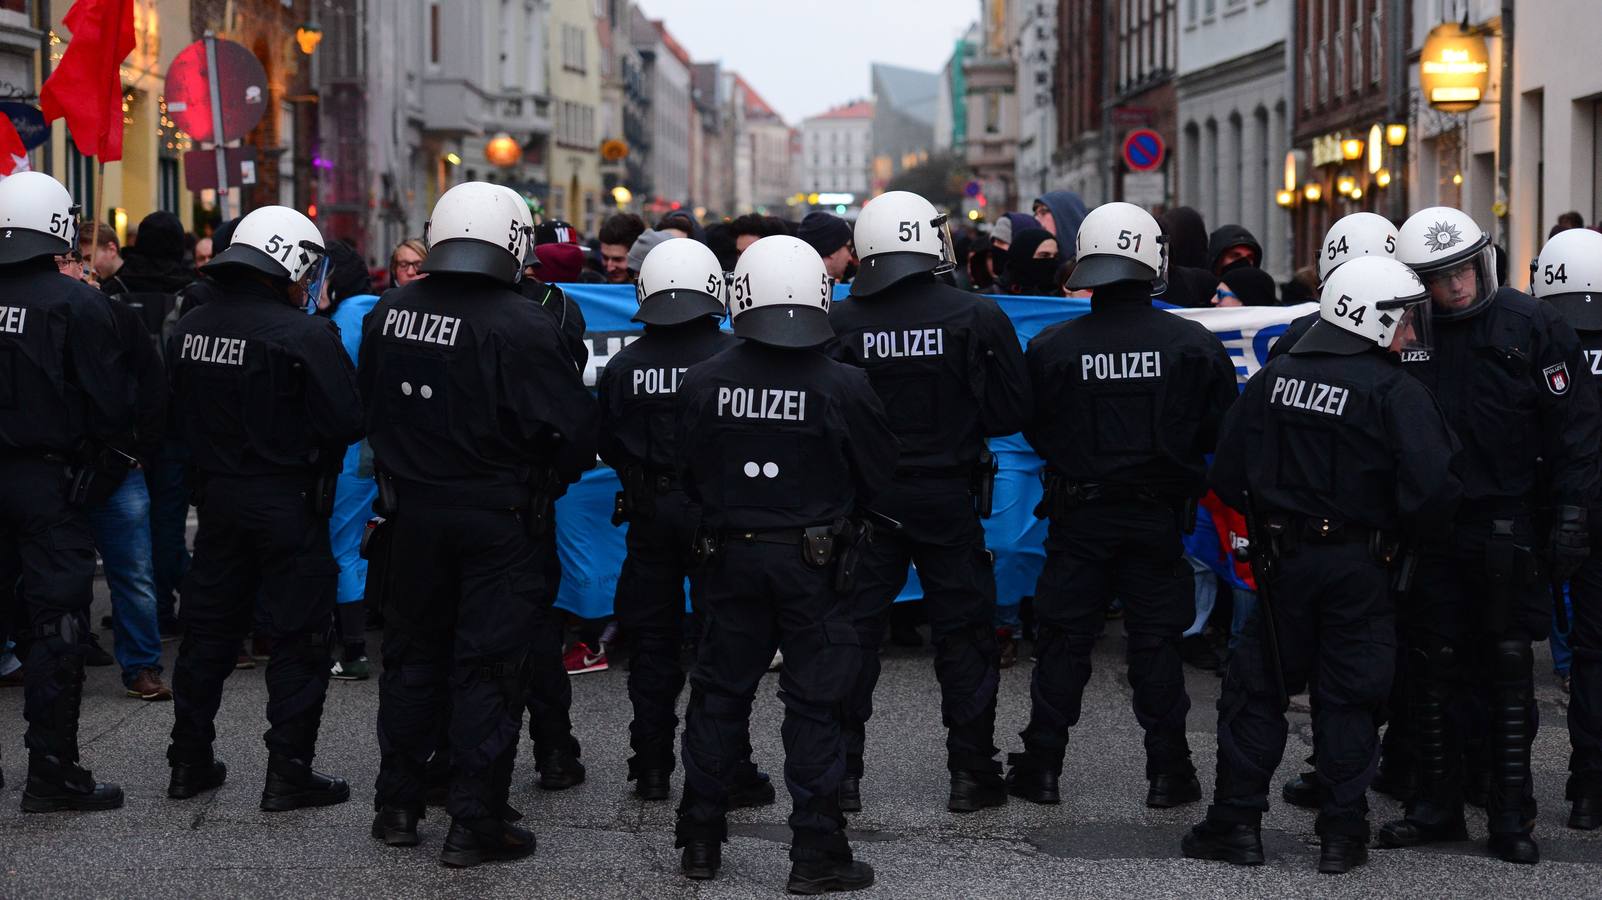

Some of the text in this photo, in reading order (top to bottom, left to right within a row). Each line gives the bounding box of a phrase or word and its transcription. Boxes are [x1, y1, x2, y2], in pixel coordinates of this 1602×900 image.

[5, 230, 12, 238] 2
[49, 213, 69, 238] 51
[898, 221, 921, 242] 51
[265, 234, 294, 263] 51
[1116, 229, 1142, 253] 51
[1327, 235, 1350, 261] 54
[870, 258, 876, 267] 1
[1544, 263, 1568, 286] 54
[670, 291, 677, 300] 1
[705, 273, 722, 299] 51
[734, 272, 752, 301] 51
[1584, 294, 1592, 303] 3
[787, 308, 795, 318] 1
[1334, 294, 1367, 328] 54
[382, 308, 462, 347] POLIZEI
[181, 333, 247, 366] POLIZEI
[862, 328, 944, 359] POLIZEI
[1081, 351, 1161, 381] POLIZEI
[717, 387, 806, 421] POLIZEI
[1270, 376, 1350, 417] POLIZEI
